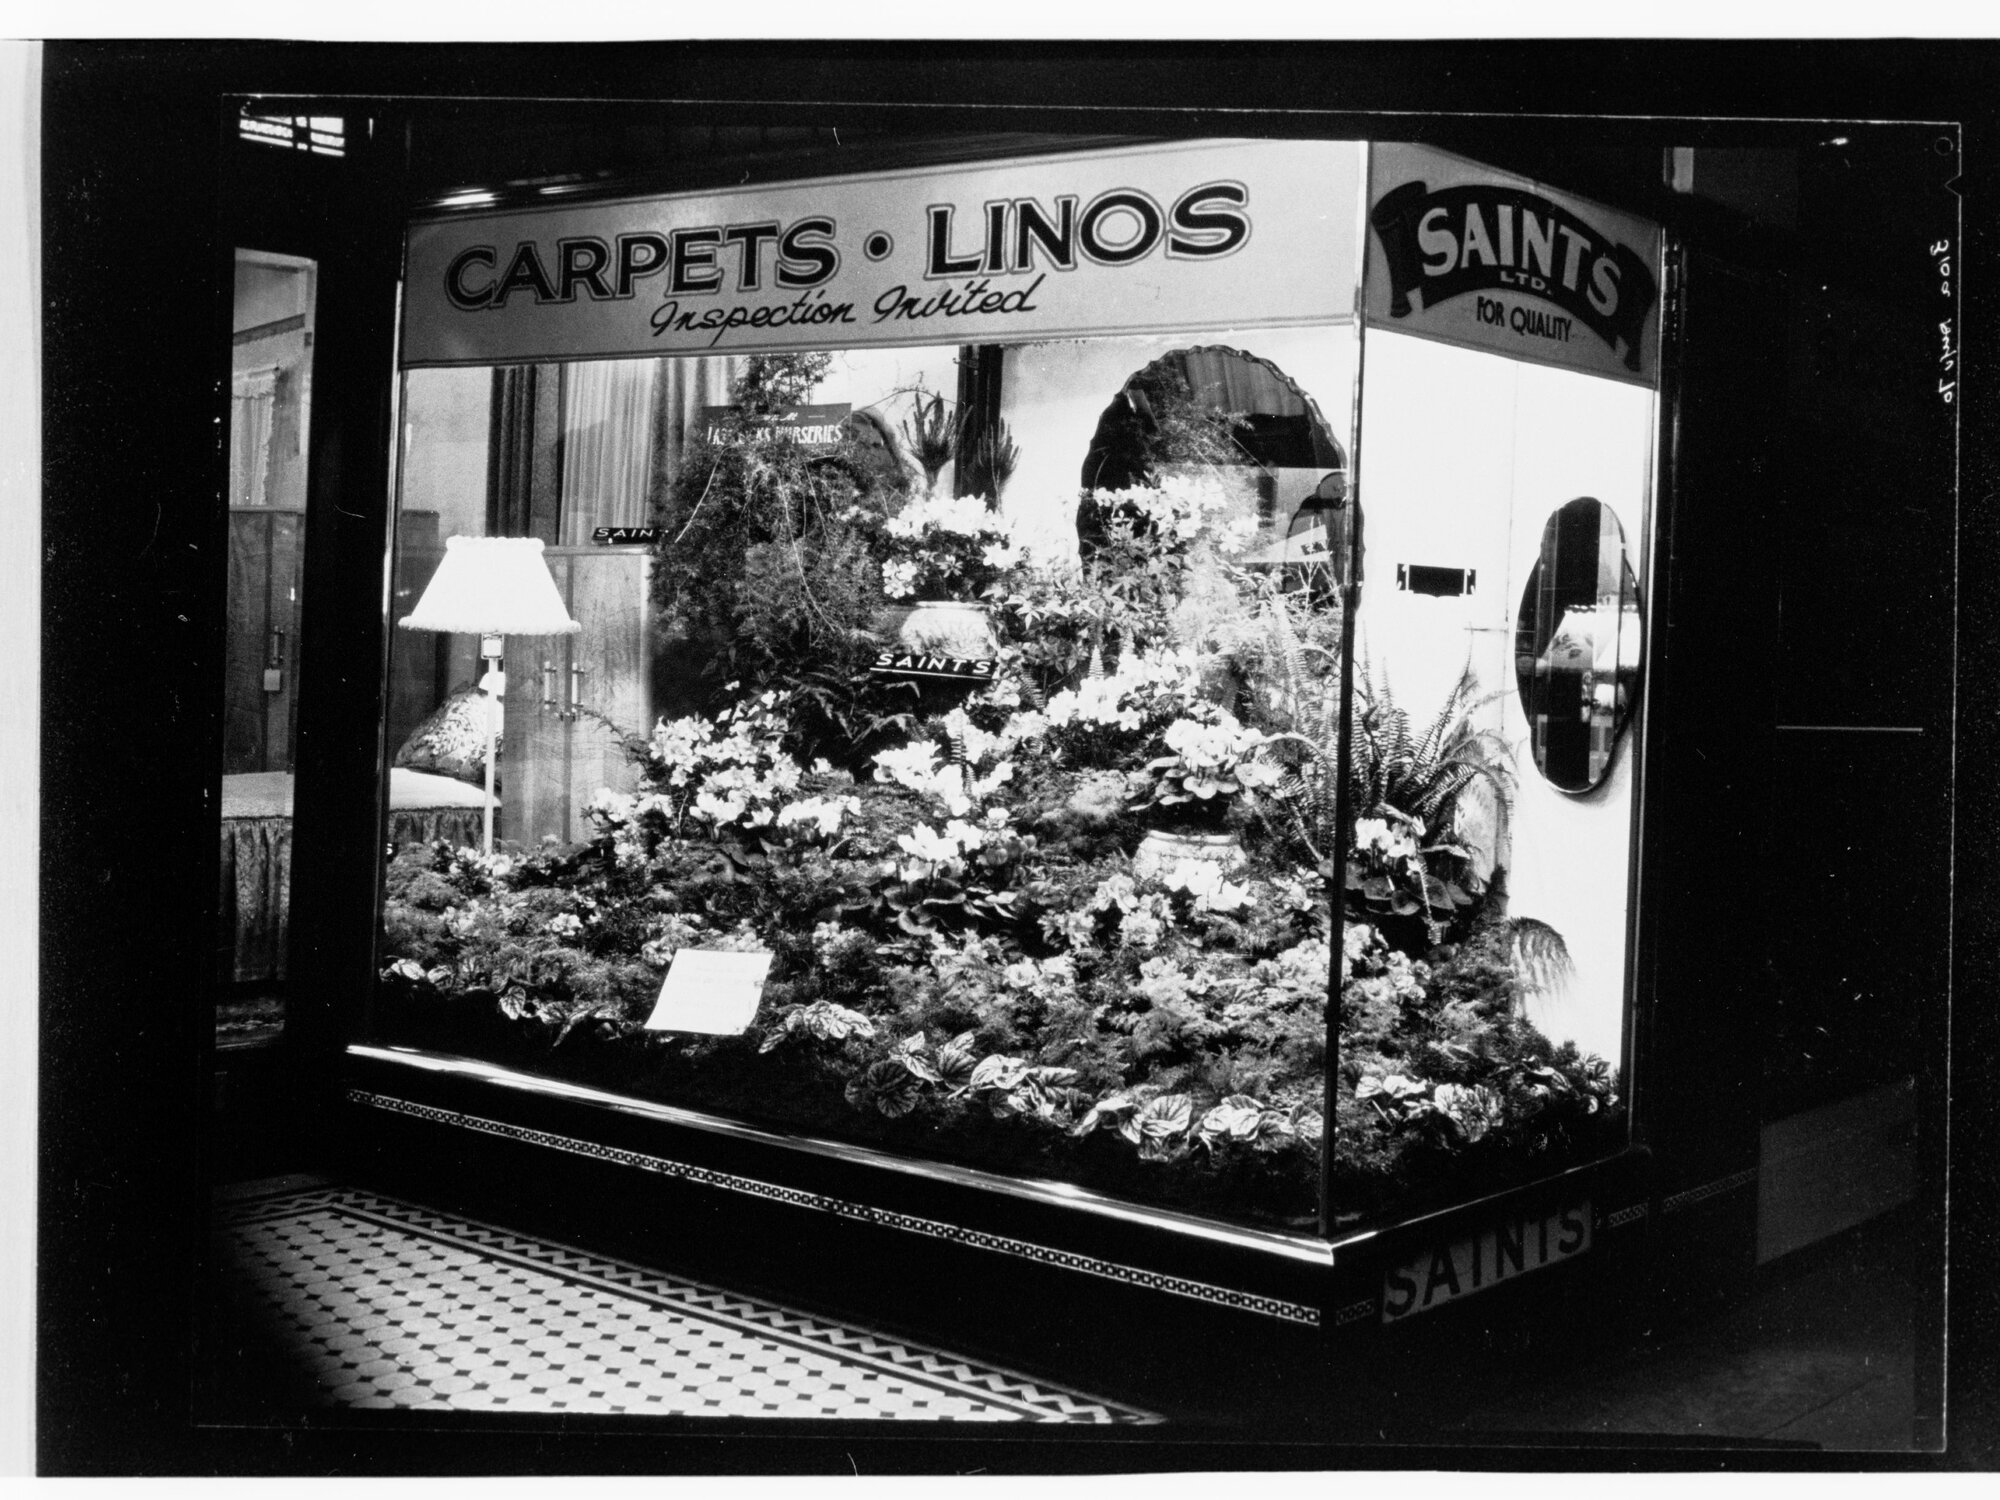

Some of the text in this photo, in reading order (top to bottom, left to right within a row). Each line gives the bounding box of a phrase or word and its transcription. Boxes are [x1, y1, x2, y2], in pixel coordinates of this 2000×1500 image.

[444, 180, 1251, 311] CARPETS LINOS
[1417, 203, 1622, 317] SAINTS
[1500, 270, 1552, 295] LTD.
[651, 273, 1045, 347] Inspection Invited
[1477, 295, 1572, 342] FOR QUALITY
[1383, 1206, 1586, 1319] SAINTS
